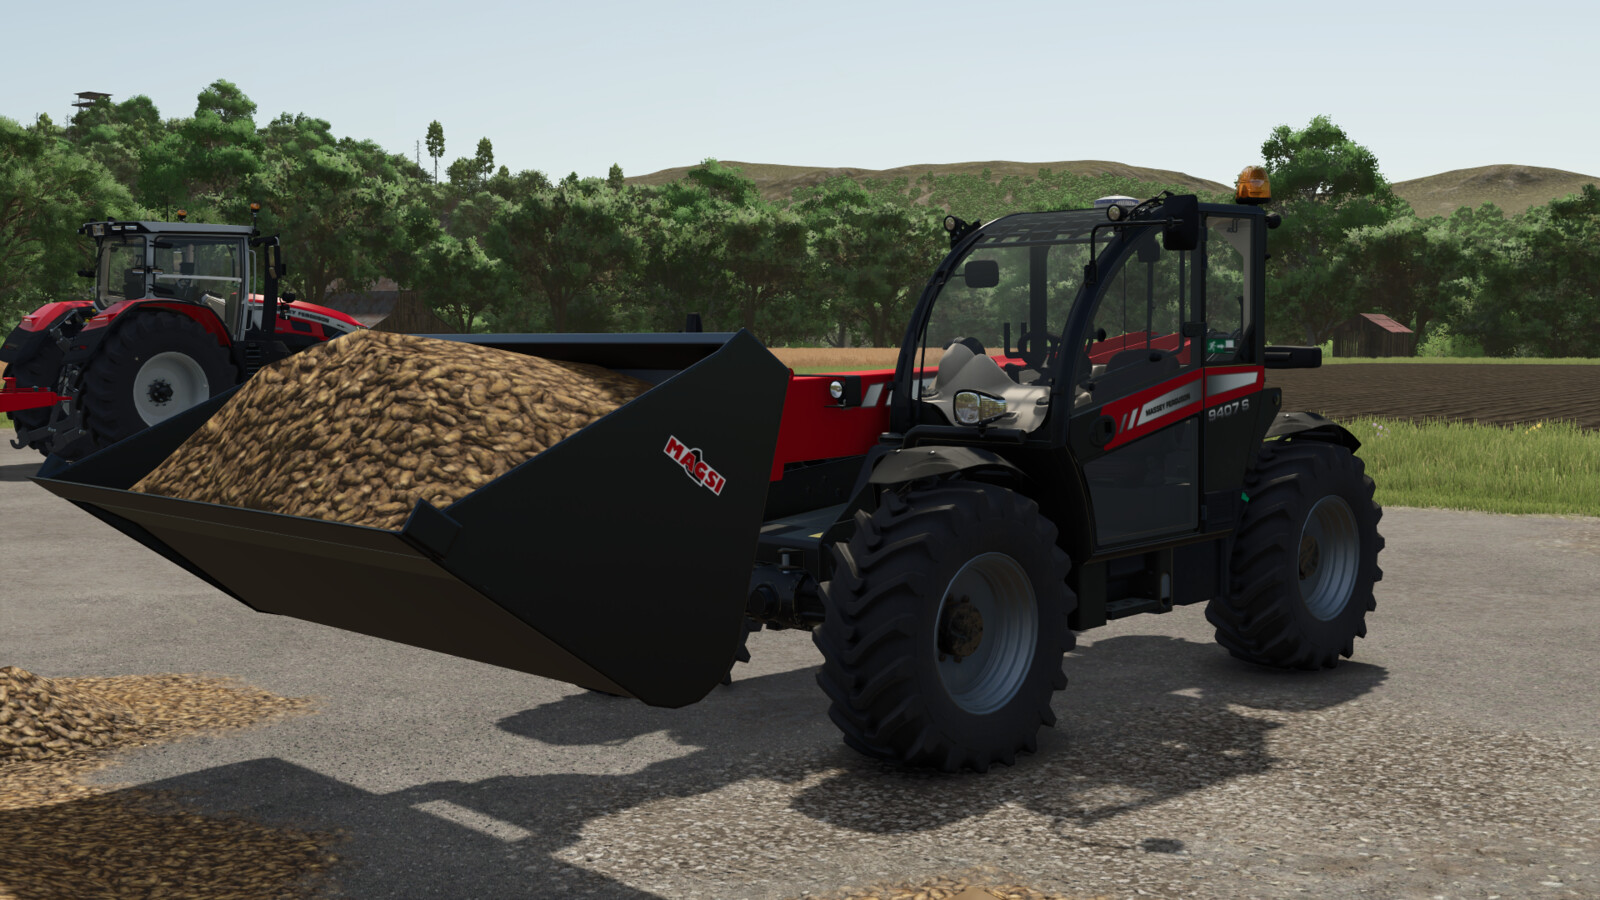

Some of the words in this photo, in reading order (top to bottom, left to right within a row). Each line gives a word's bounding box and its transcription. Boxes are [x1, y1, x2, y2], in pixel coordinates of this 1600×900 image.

[1145, 403, 1166, 416] MASSEY
[1165, 392, 1191, 408] FERGUSON
[1208, 402, 1240, 421] 9407
[664, 435, 726, 495] MAGSI
